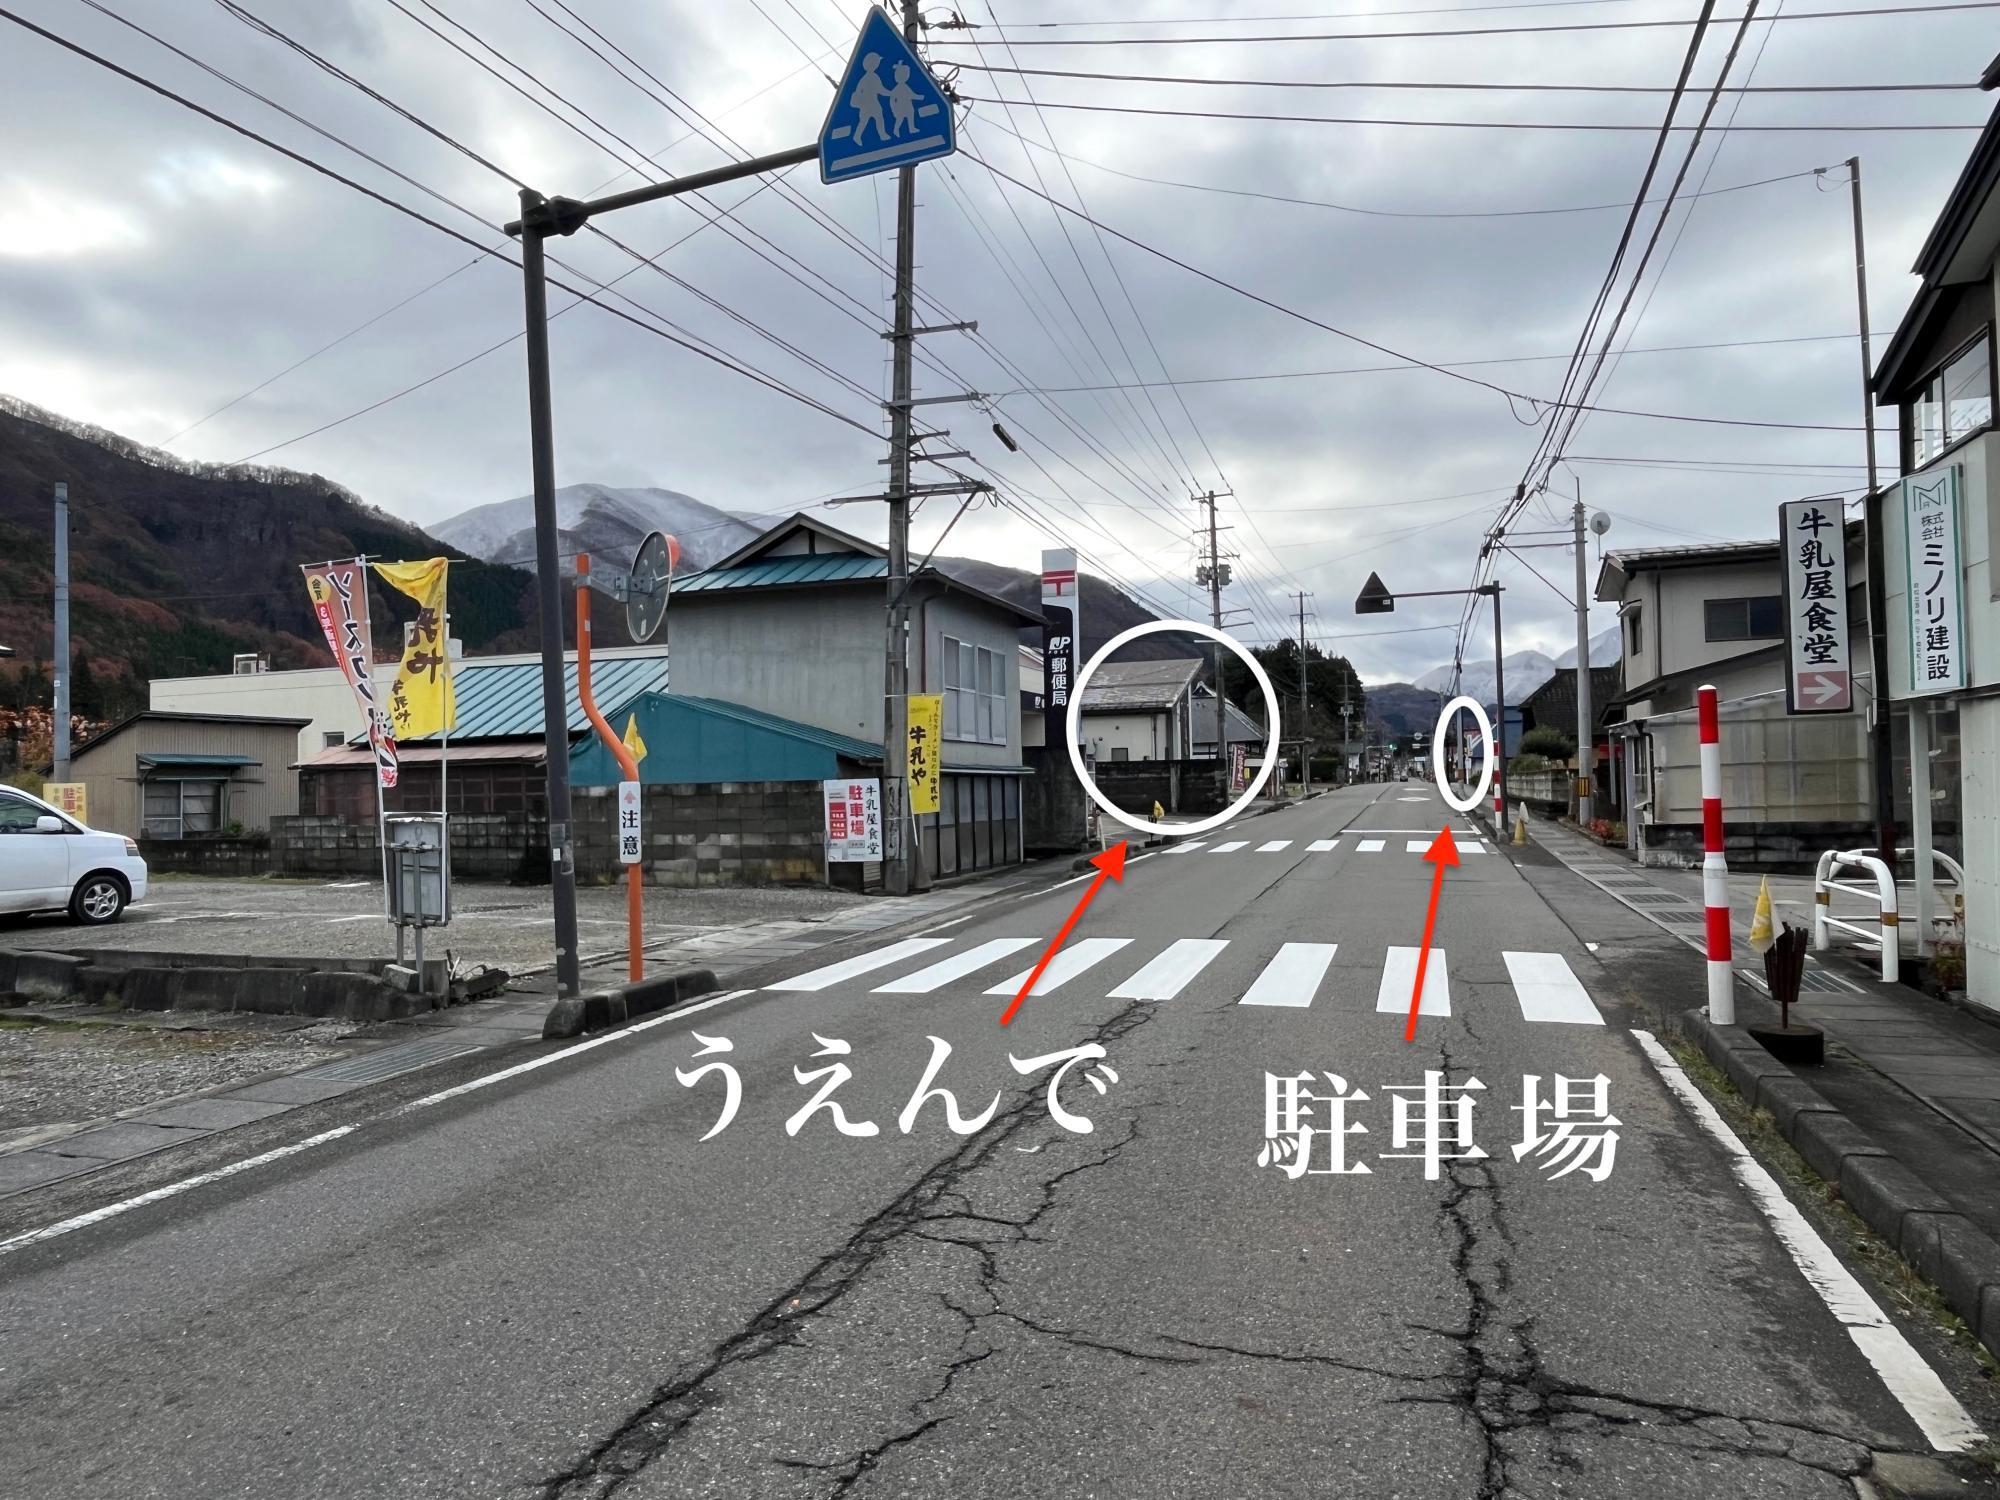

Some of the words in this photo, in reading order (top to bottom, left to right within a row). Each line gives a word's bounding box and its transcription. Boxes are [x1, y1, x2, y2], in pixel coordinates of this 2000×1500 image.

[1921, 511, 1945, 541] 株式会社
[1797, 508, 1839, 665] 牛乳屋食堂
[1923, 543, 1951, 681] ミノリ建設
[1049, 636, 1071, 650] JP
[1051, 657, 1067, 706] 郵便局
[909, 725, 927, 786] 牛乳や
[63, 787, 76, 814] 駐車
[848, 785, 865, 836] 駐車場
[865, 785, 880, 856] 牛乳屋食堂
[622, 810, 639, 856] 注意
